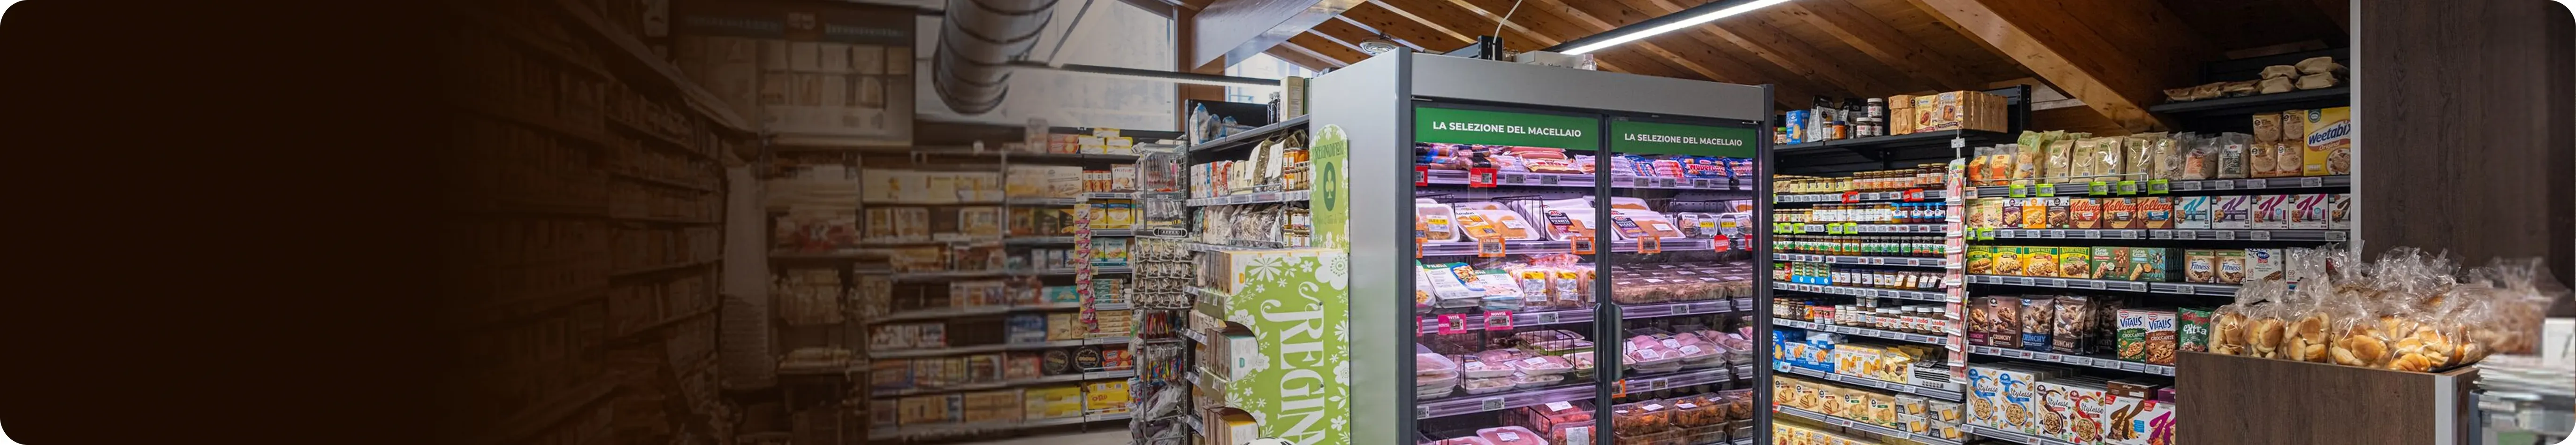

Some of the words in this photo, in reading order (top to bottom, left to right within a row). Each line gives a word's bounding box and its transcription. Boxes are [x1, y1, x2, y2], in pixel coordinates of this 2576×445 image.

[1433, 121, 1446, 130] LA
[1449, 123, 1504, 133] SELEZIONE
[1507, 126, 1525, 134] DEL
[1528, 127, 1581, 138] MACELLAIO
[2309, 122, 2351, 145] Weetabix
[1637, 134, 1681, 143] SELEZIONE
[1700, 138, 1742, 146] MACELLAIO
[2191, 261, 2210, 271] Fitness
[2222, 261, 2241, 272] Fitness
[2120, 316, 2142, 328] VITALIS
[2149, 319, 2172, 330] VITALIS
[1977, 383, 1998, 393] Stylesse
[2010, 388, 2033, 399] Stylesse
[2048, 397, 2069, 408] Stylesse
[2081, 403, 2104, 414] Stylesse
